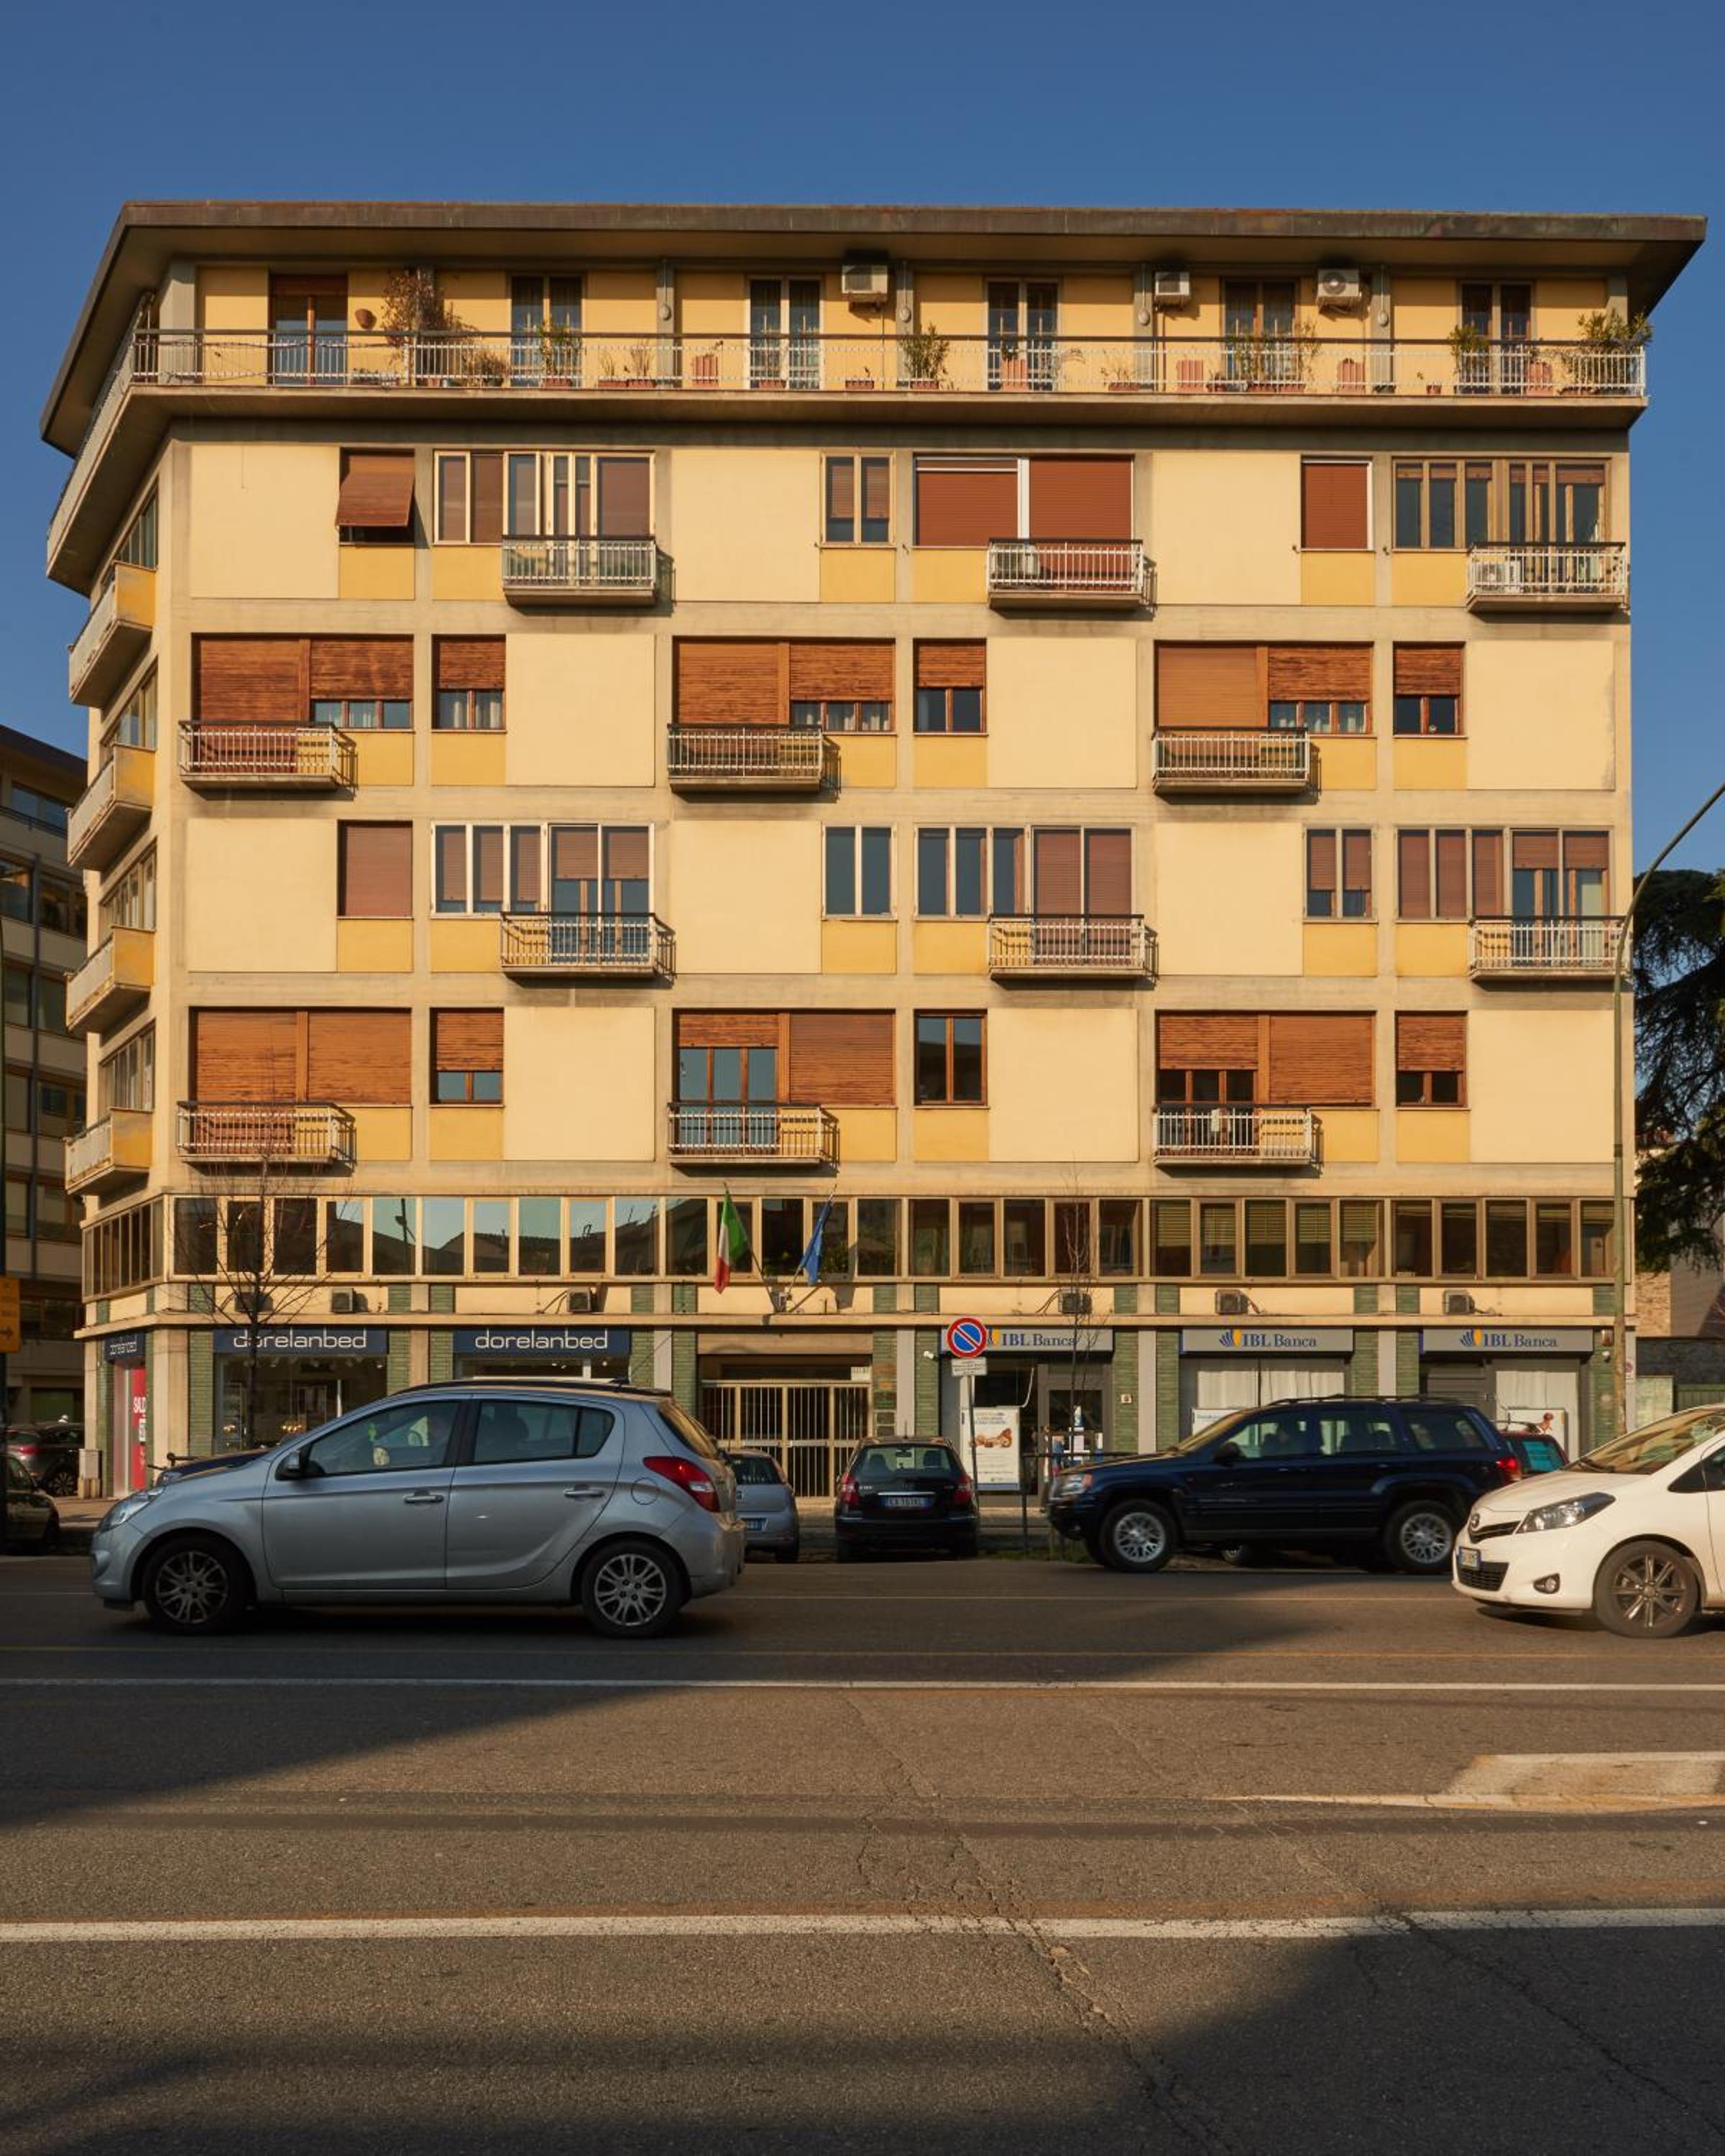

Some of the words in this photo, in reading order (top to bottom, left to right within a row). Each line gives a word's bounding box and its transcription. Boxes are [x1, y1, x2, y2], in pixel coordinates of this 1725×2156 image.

[474, 1328, 607, 1349] dorelanbed
[1003, 1333, 1030, 1346] IBL
[1033, 1333, 1077, 1346] Banca
[1243, 1333, 1271, 1347] IBL
[1274, 1333, 1317, 1347] Banca
[1484, 1333, 1512, 1347] IBL
[1514, 1333, 1558, 1347] Banca
